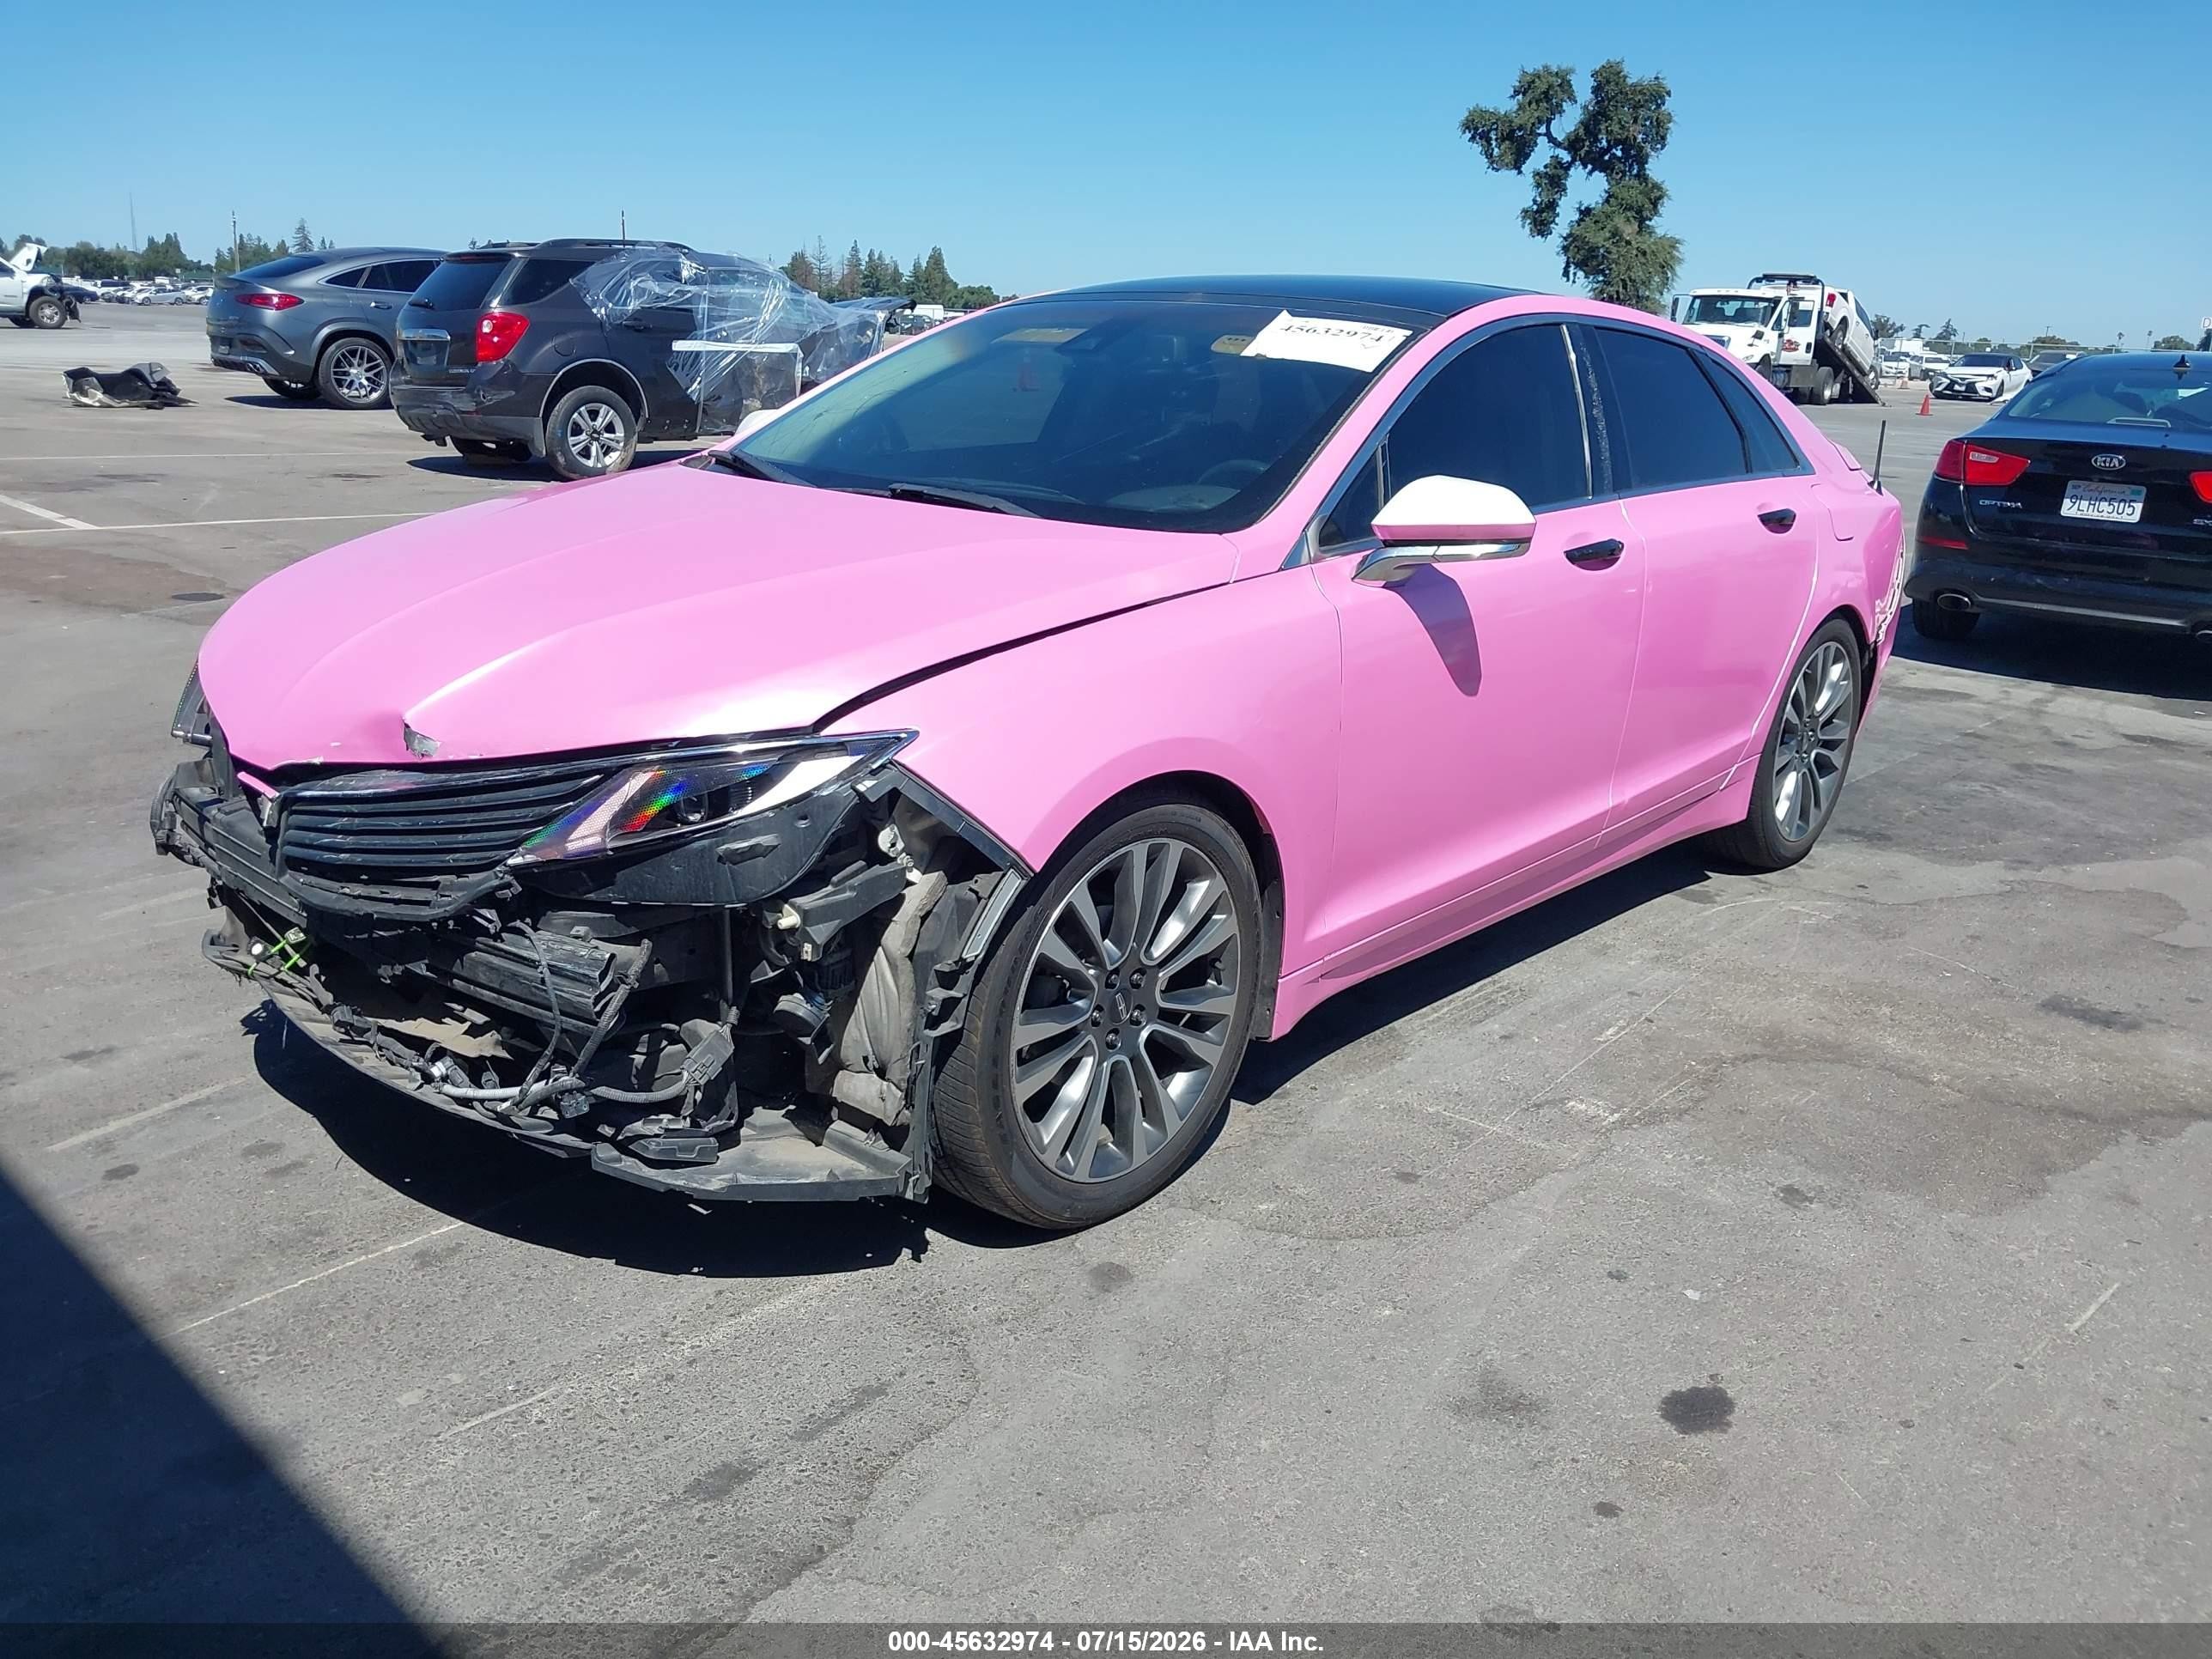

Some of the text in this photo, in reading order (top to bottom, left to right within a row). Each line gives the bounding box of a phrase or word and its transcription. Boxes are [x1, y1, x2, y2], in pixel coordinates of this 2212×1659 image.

[1279, 324, 1384, 343] 45632974
[2096, 456, 2120, 468] KIA
[2067, 494, 2137, 517] 9LHC505
